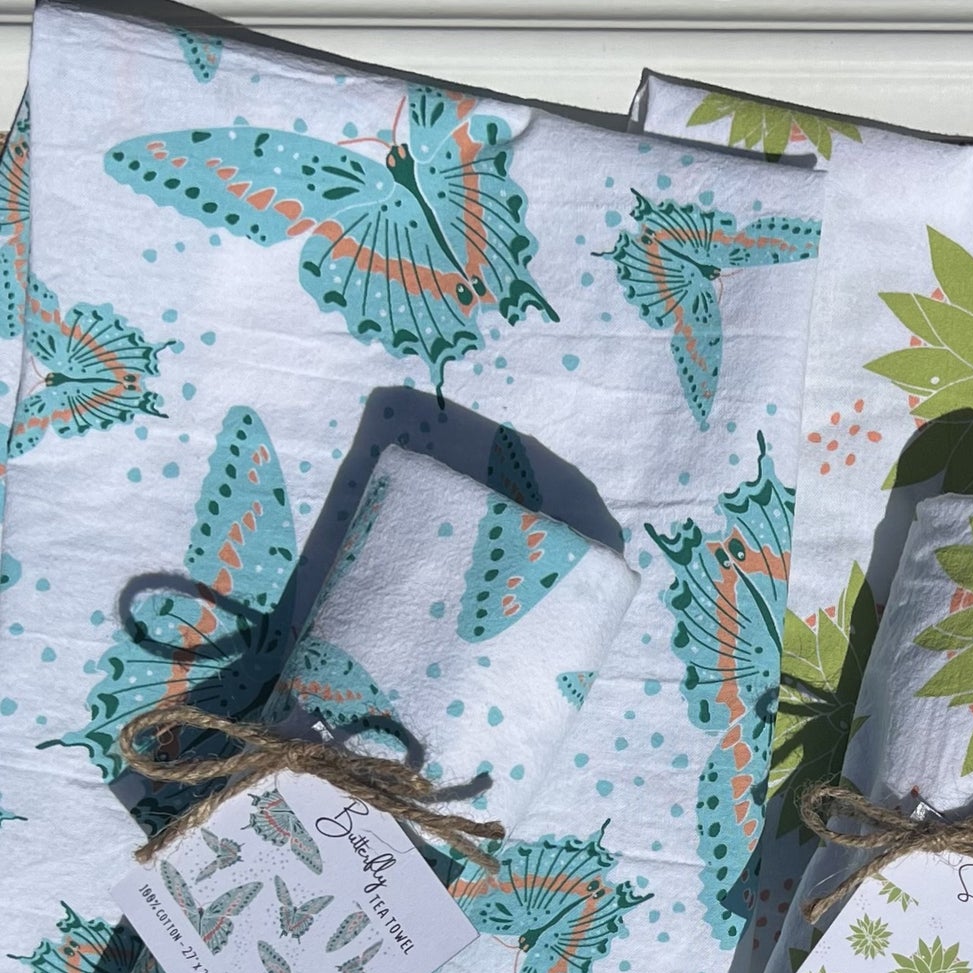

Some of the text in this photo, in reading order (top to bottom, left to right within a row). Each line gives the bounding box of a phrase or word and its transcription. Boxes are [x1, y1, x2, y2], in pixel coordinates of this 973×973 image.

[315, 798, 397, 894] Butterfly
[138, 884, 161, 910] 100%
[156, 909, 182, 942] COTTON
[369, 894, 415, 956] TEA TOWEL
